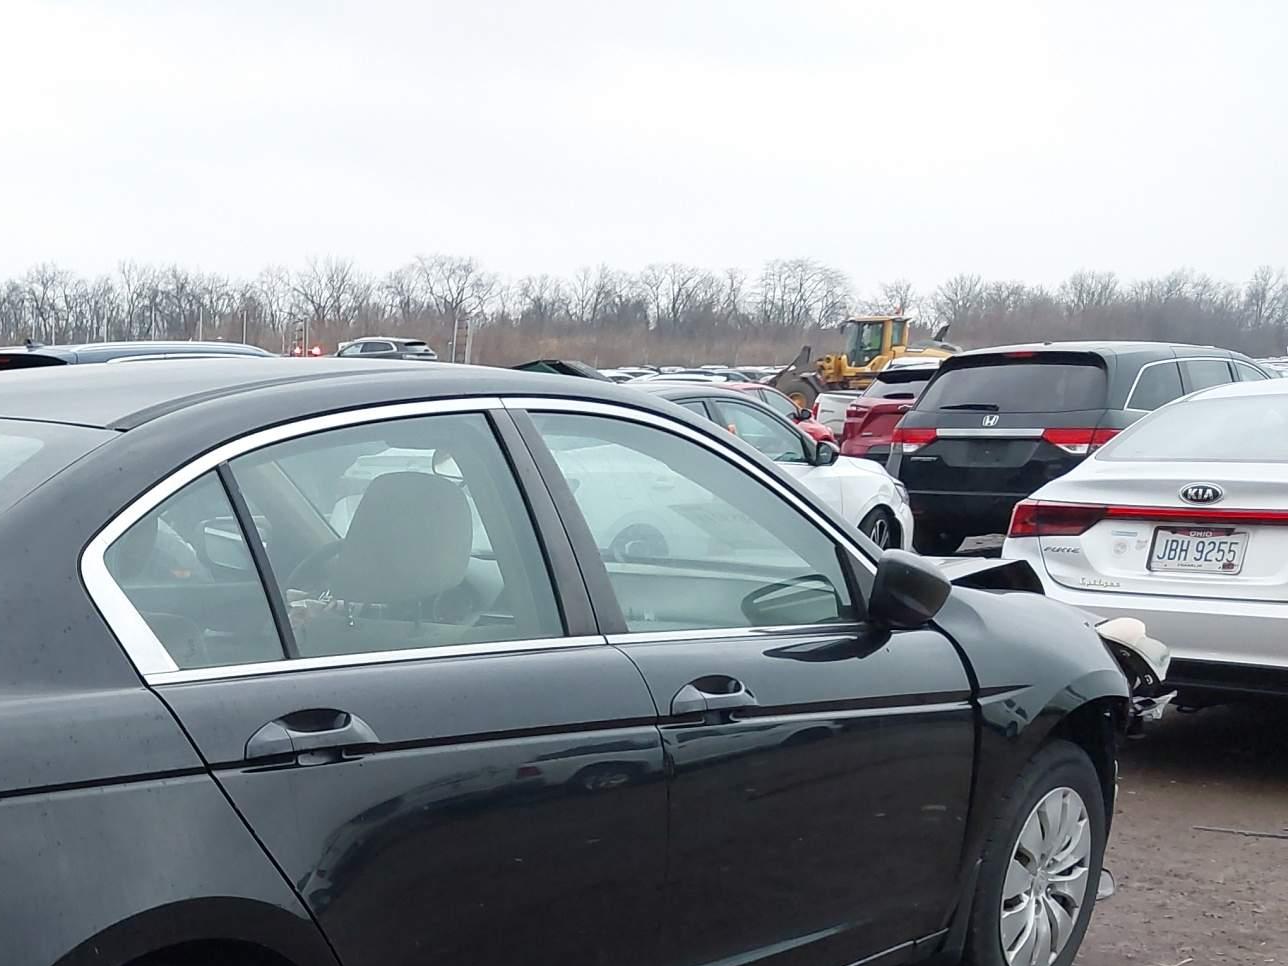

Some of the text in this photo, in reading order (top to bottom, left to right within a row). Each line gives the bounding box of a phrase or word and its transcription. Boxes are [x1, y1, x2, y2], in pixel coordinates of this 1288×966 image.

[1187, 488, 1214, 501] KIA
[1189, 530, 1213, 538] OHIO
[1156, 539, 1240, 563] JBH 9255
